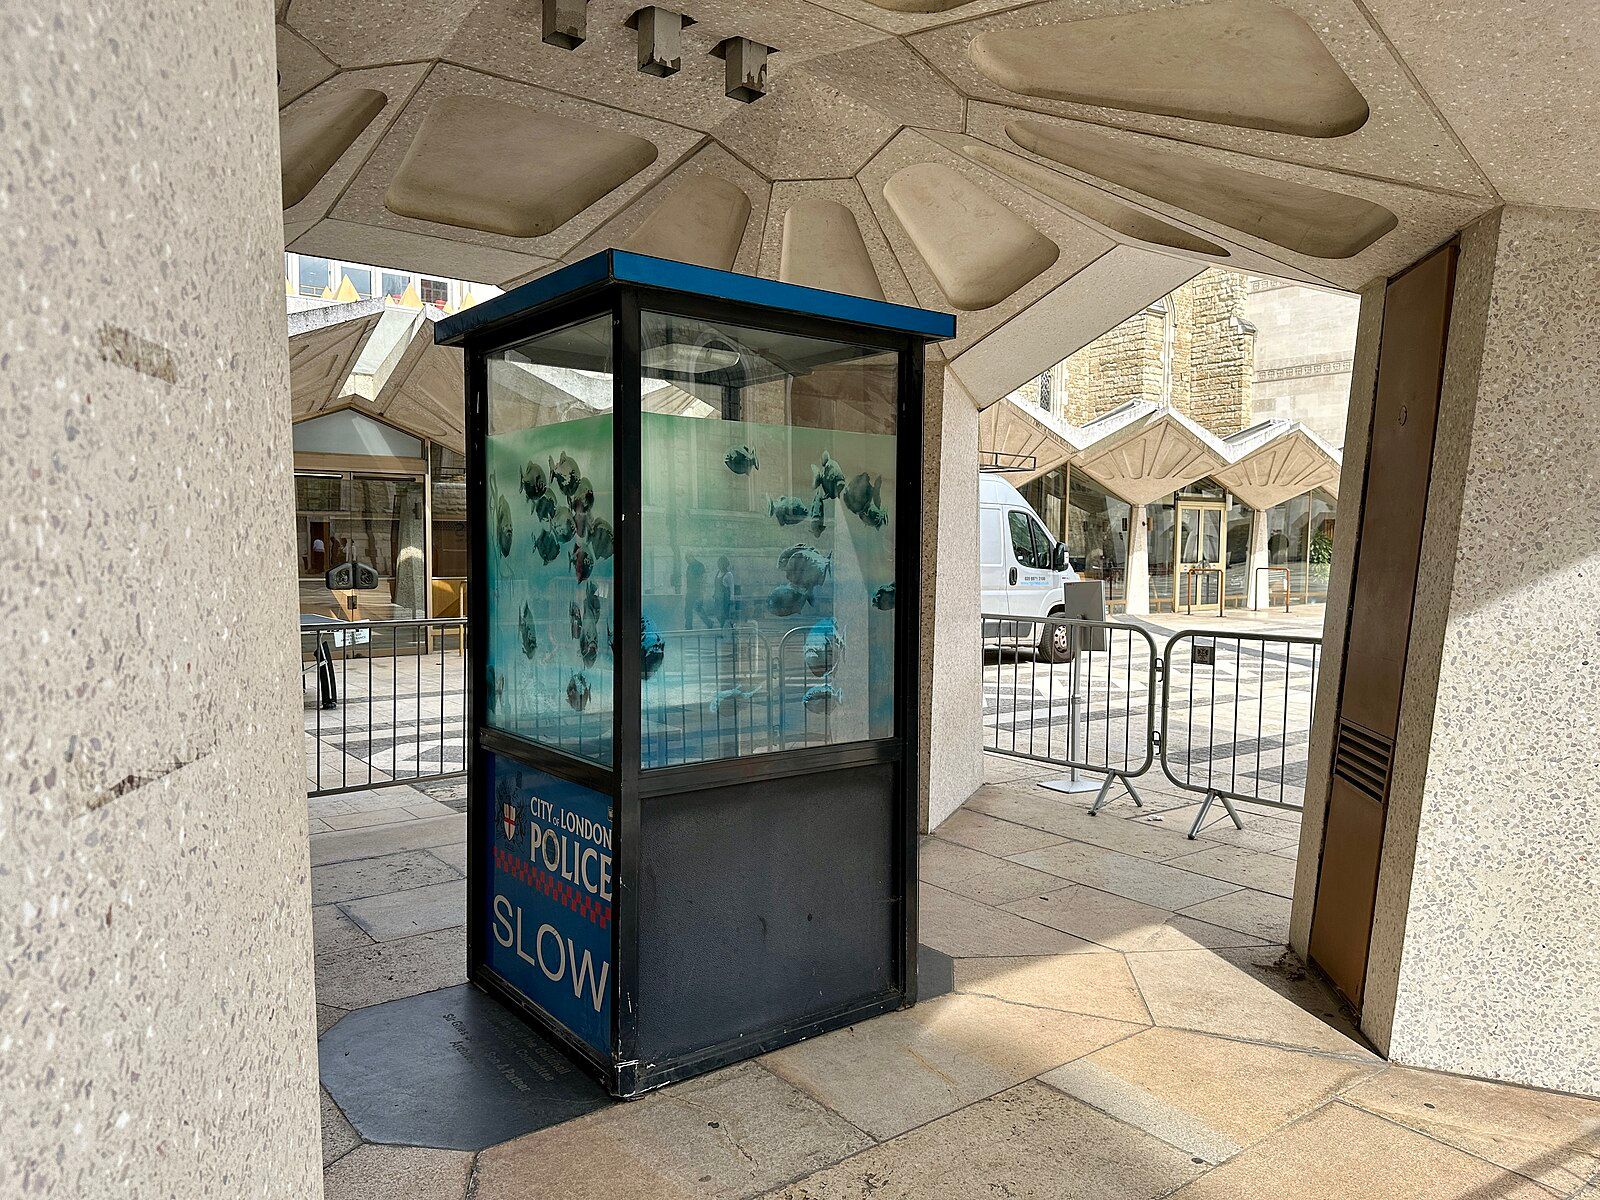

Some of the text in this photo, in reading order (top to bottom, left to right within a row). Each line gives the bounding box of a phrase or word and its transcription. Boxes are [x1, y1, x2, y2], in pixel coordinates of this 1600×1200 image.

[530, 796, 612, 851] CITY OF LONDON
[530, 821, 613, 902] POLICE
[492, 894, 609, 1013] SLOW
[502, 1067, 531, 1092] Partner
[515, 1049, 555, 1081] Committee
